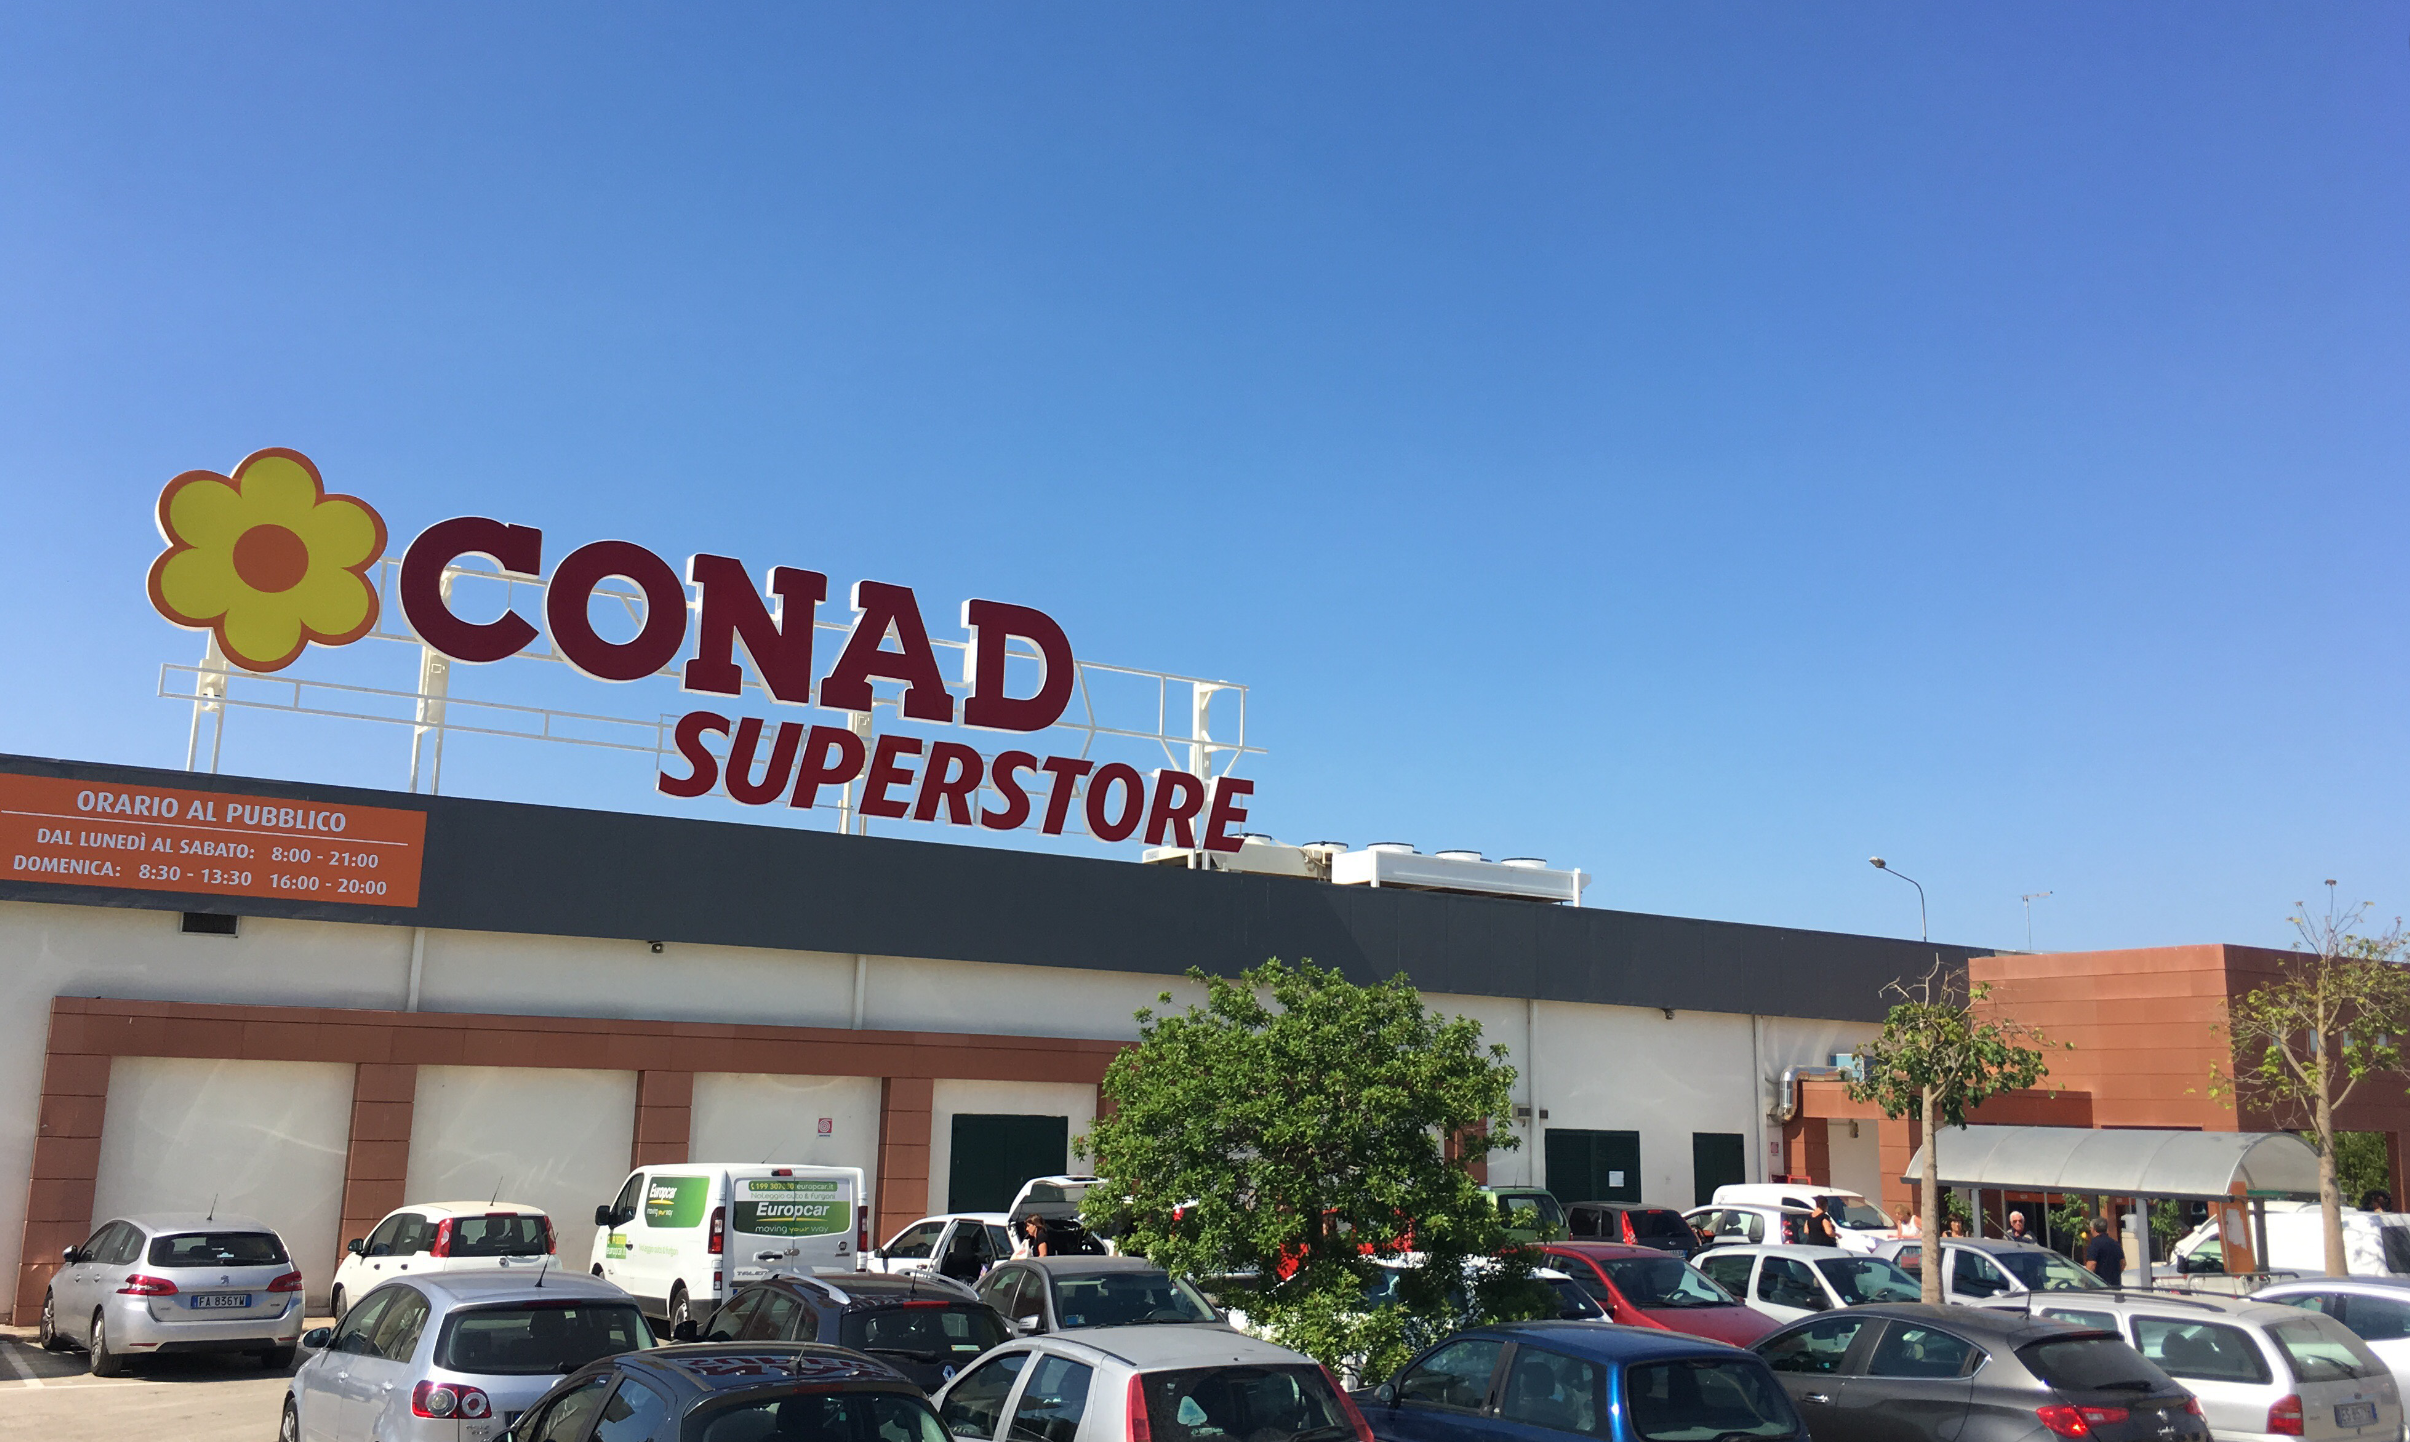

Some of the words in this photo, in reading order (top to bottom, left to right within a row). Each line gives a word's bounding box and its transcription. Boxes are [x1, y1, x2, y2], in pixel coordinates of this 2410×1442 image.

[401, 516, 1075, 732] CONAD
[658, 711, 1255, 854] SUPERSTORE
[76, 790, 179, 818] ORARIO
[185, 799, 217, 822] AL
[226, 803, 346, 833] PUBBLICO
[36, 827, 74, 846] DAL
[79, 831, 146, 851] LUNEDÌ
[150, 837, 174, 853] AL
[179, 839, 255, 859] SABATO:
[271, 846, 312, 864] 8:00
[328, 851, 379, 869] 21:00
[13, 854, 121, 877] DOMENICA:
[138, 863, 181, 881] 8:30
[201, 868, 252, 887] 13:30
[269, 873, 320, 891] 16:00
[337, 878, 387, 896] 20:00
[649, 1183, 677, 1201] Europcar
[796, 1182, 834, 1191] europcar.it
[756, 1201, 830, 1221] Europcar
[754, 1225, 788, 1234] moving
[788, 1226, 810, 1234] your
[811, 1225, 829, 1233] way
[199, 1296, 212, 1307] FA
